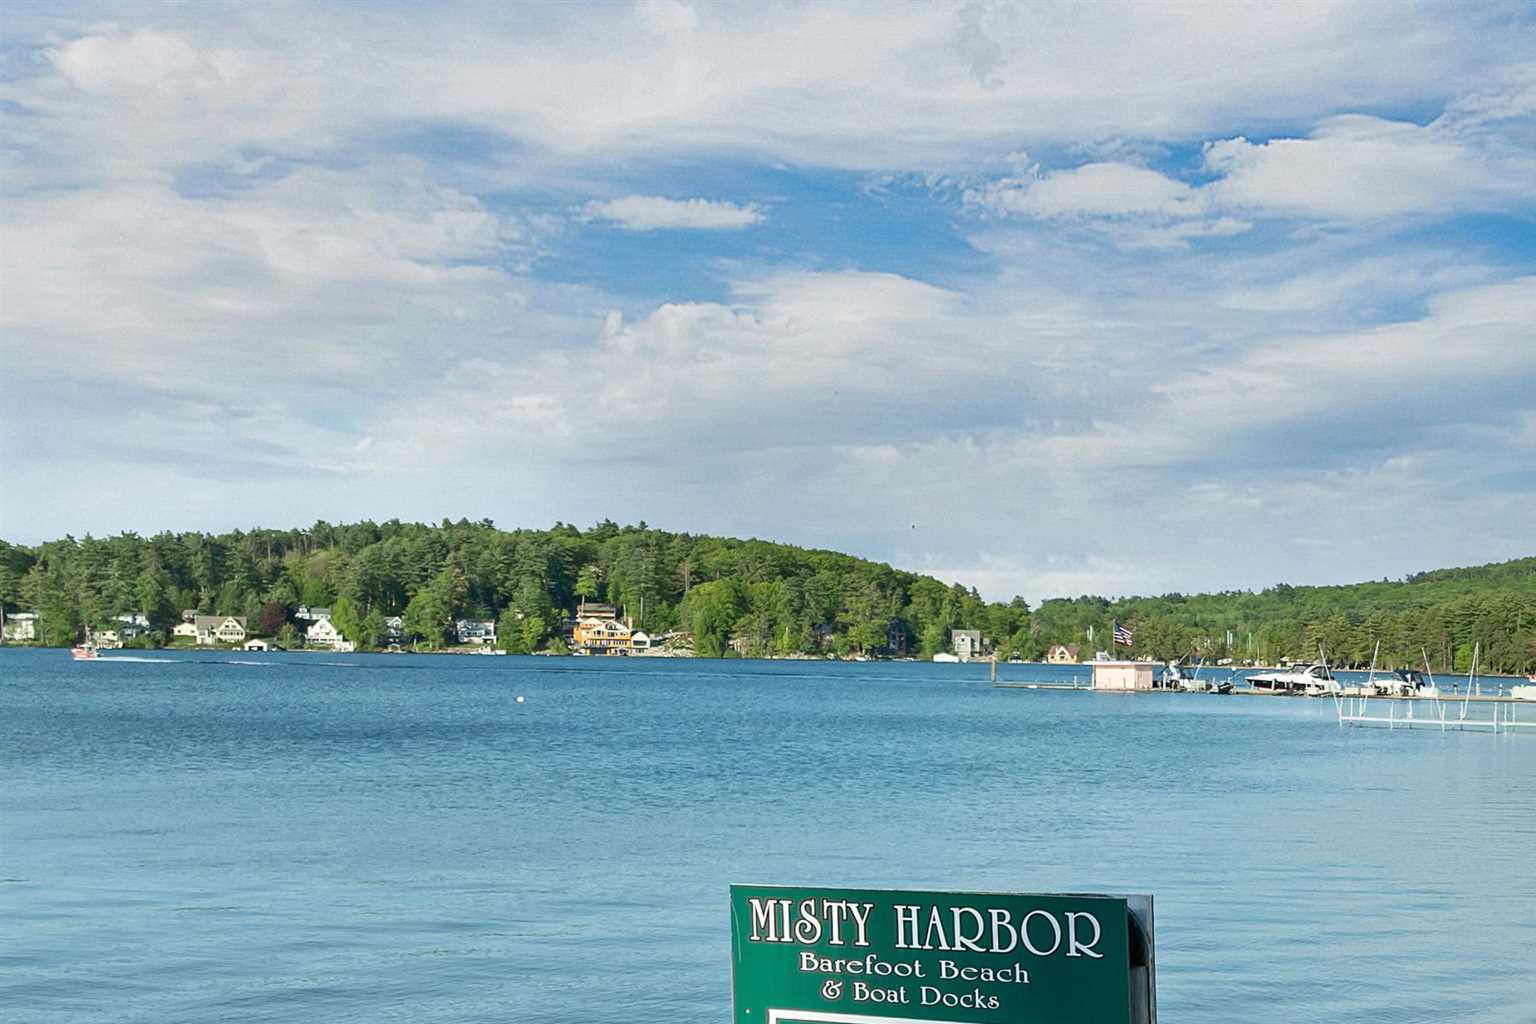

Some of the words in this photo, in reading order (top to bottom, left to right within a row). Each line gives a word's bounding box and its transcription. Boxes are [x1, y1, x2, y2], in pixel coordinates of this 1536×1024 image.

[748, 898, 874, 947] MISTY
[893, 904, 1104, 959] HARBOR
[799, 952, 926, 979] Barefoot
[938, 959, 1030, 984] Beach
[822, 980, 842, 1000] &
[853, 982, 910, 1005] Boat
[920, 986, 1000, 1010] Docks
